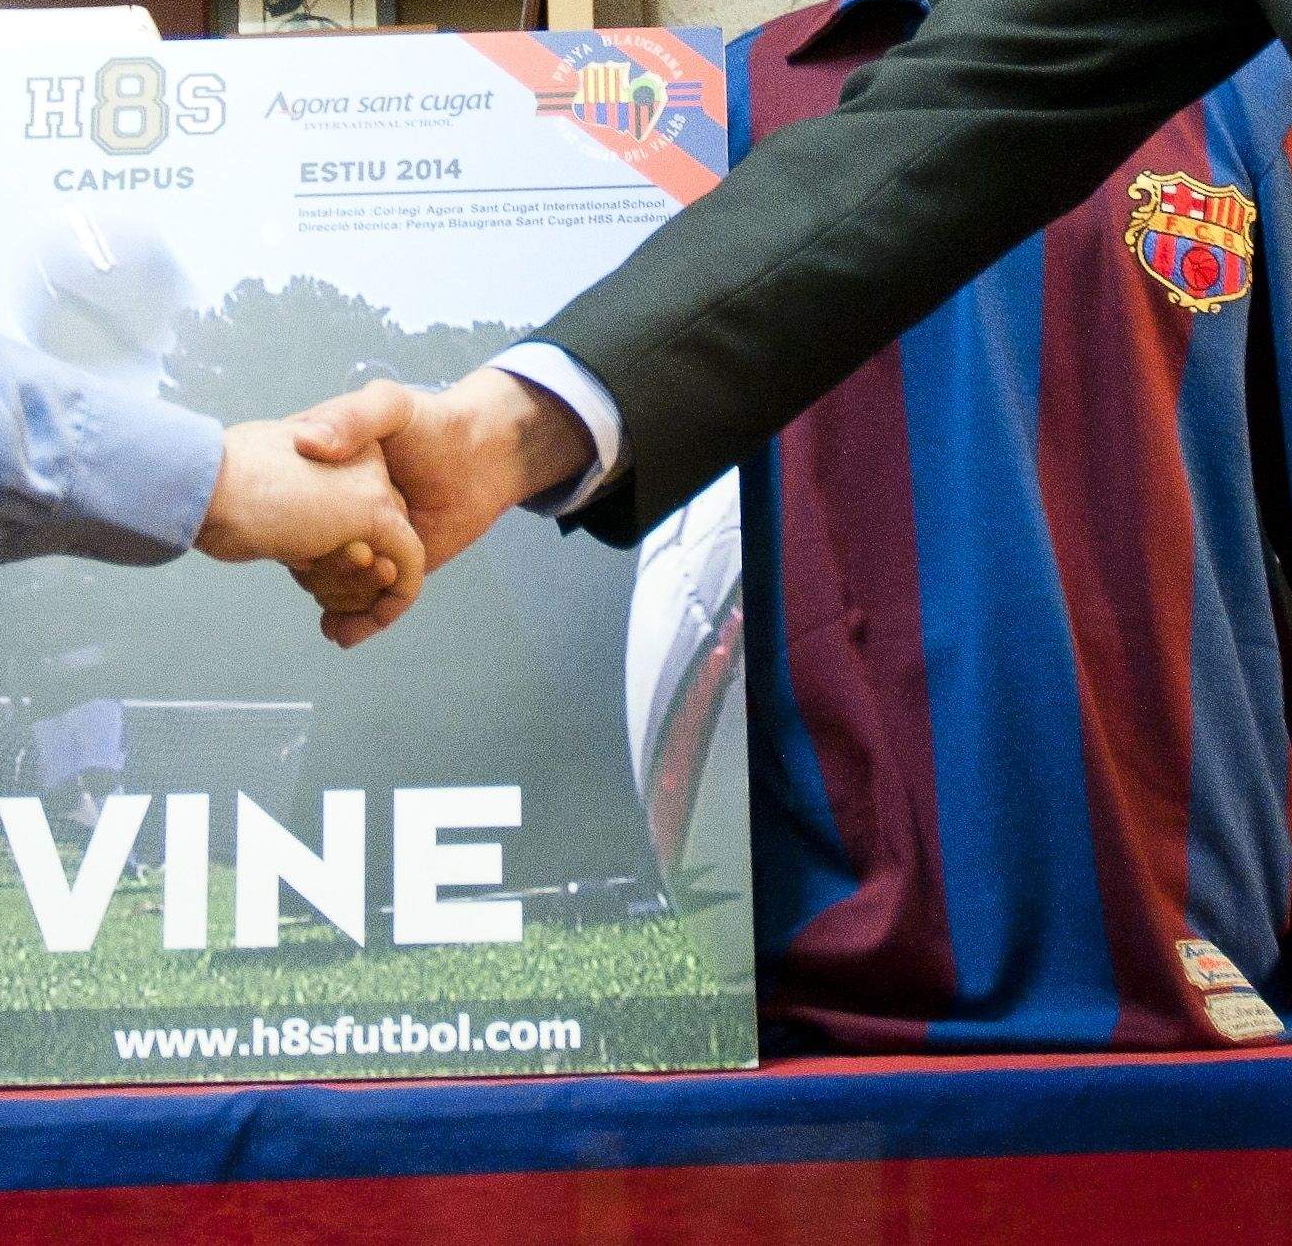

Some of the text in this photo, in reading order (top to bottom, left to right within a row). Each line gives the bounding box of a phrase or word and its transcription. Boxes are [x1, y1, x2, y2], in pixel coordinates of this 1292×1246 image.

[24, 57, 227, 155] H8S
[264, 90, 495, 121] Agora sant cugat
[304, 118, 455, 131] INTERNATIONAL SCHOOL
[53, 166, 195, 192] CAMPUS
[300, 157, 463, 183] ESTIU 2014
[470, 203, 500, 214] Sant
[502, 201, 540, 214] Cugat
[448, 217, 512, 230] Blaugrana
[515, 216, 545, 227] Sant
[547, 215, 585, 228] Cugat
[113, 1012, 582, 1060] www.h8sfutbol.com
